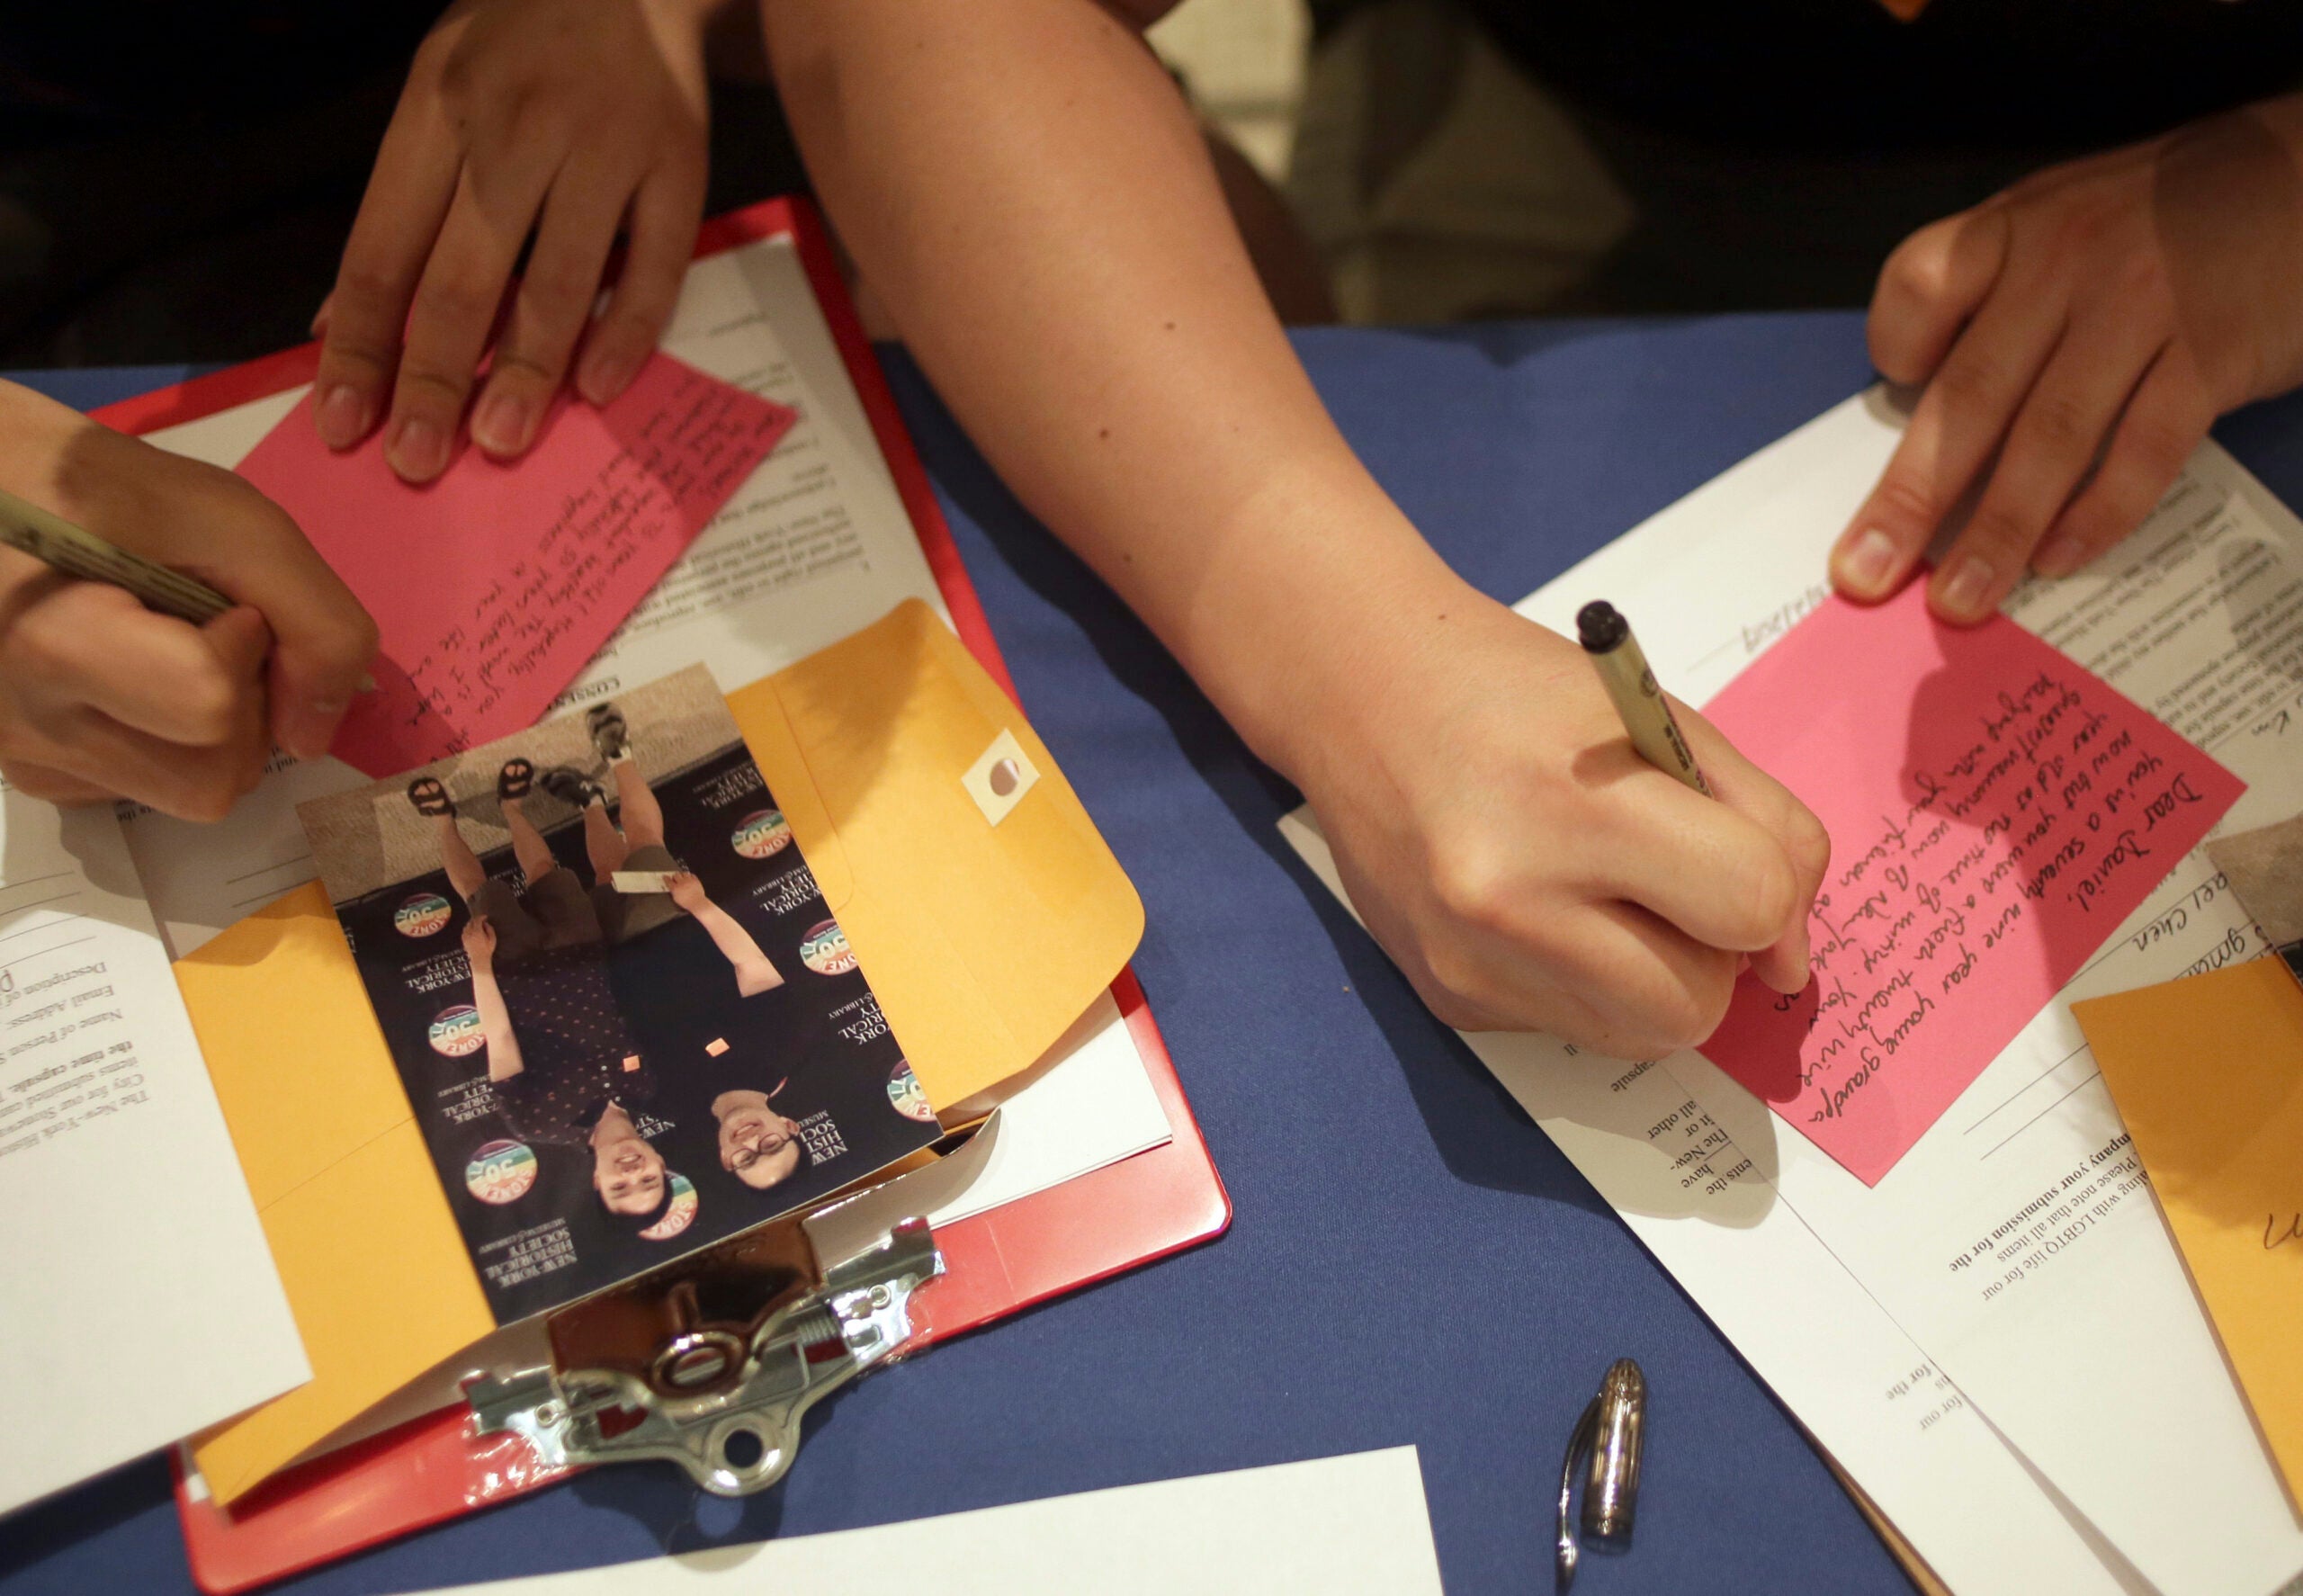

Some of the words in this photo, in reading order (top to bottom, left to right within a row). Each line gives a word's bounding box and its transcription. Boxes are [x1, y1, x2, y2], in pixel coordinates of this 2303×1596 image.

[2092, 730, 2131, 774] now
[2062, 771, 2091, 810] but
[2144, 772, 2202, 830] Dear
[2023, 808, 2056, 846] you
[2086, 811, 2100, 832] a
[1940, 845, 1985, 884] time
[2016, 838, 2084, 899] seventy
[2067, 829, 2149, 910] Daniel,
[1962, 893, 1975, 909] a
[1842, 890, 1888, 941] New
[1983, 903, 2021, 948] nine
[2133, 908, 2187, 950] Chen
[817, 934, 847, 959] 50
[1806, 919, 1856, 970] York
[23, 962, 106, 994] Description
[1942, 945, 1977, 993] year
[71, 984, 114, 1007] Email
[829, 998, 864, 1018] LIBRARY
[1806, 981, 1857, 1033] Your
[1839, 969, 1913, 1037] twenty
[79, 1009, 122, 1028] Name
[444, 1019, 473, 1041] 50
[1868, 984, 1934, 1054] young
[71, 1050, 104, 1068] time
[108, 1040, 132, 1054] the
[1796, 1038, 1845, 1086] nine
[1610, 1061, 1655, 1091] capsule
[1809, 1046, 1879, 1122] grandpa
[120, 1089, 148, 1105] The
[1678, 1099, 1696, 1118] all
[1647, 1113, 1679, 1139] other
[1685, 1123, 1698, 1137] or
[482, 1156, 517, 1184] 50
[1670, 1144, 1706, 1170] New-
[1680, 1163, 1714, 1188] have
[2060, 1161, 2089, 1189] your
[2096, 1156, 2136, 1187] Please
[1706, 1177, 1727, 1195] the
[2070, 1184, 2097, 1206] note
[1992, 1188, 2058, 1239] submission
[2046, 1205, 2072, 1225] that
[2092, 1194, 2120, 1215] with
[509, 1227, 569, 1256] SOCIETY
[2030, 1222, 2047, 1240] all
[2045, 1214, 2094, 1253] LGBTQ
[485, 1238, 573, 1278] HISTORICAL
[1972, 1237, 1994, 1256] for
[1996, 1234, 2030, 1261] items
[2022, 1250, 2048, 1269] life
[498, 1251, 577, 1287] NEW-YORK
[1949, 1253, 1972, 1271] the
[2003, 1266, 2024, 1284] for
[1982, 1281, 2003, 1300] our
[1909, 1363, 1931, 1383] for
[1887, 1380, 1909, 1399] the
[1941, 1394, 1962, 1412] for
[1919, 1410, 1940, 1430] our
